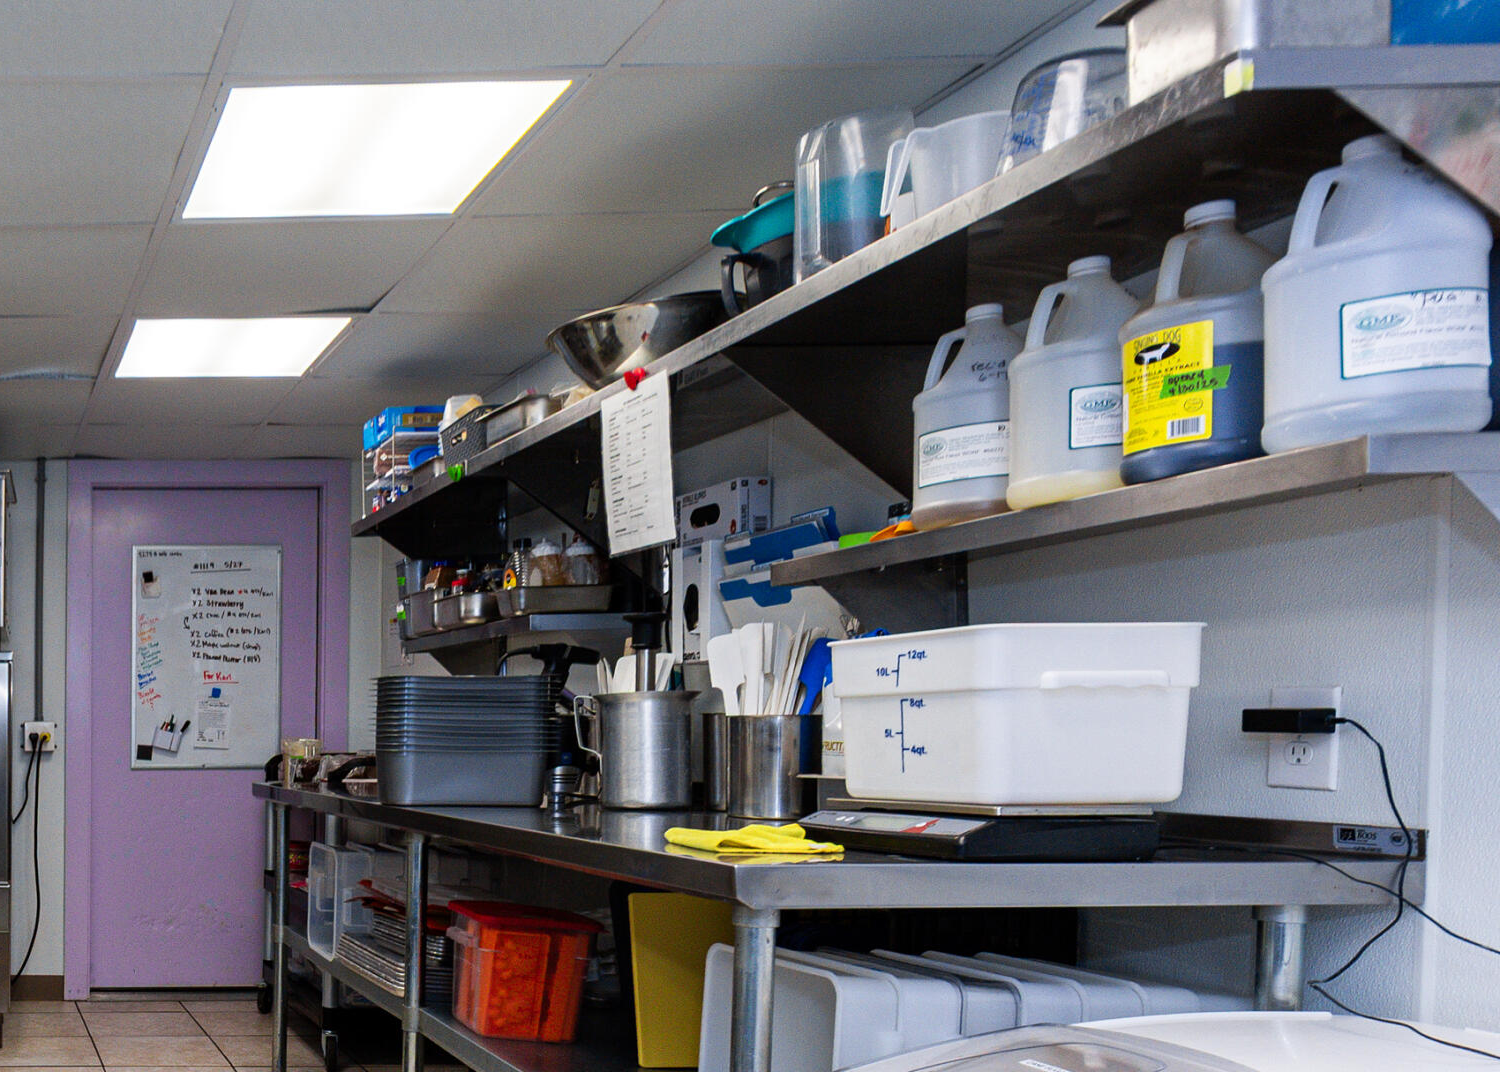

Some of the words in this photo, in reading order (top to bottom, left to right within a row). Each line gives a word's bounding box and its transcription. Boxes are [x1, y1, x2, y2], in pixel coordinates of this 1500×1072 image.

[1162, 327, 1182, 343] DOG
[206, 600, 244, 610] Strawberry
[907, 650, 927, 660] 12qt.
[876, 667, 890, 677] 10L
[909, 698, 926, 709] 8qt.
[884, 728, 895, 738] 5L
[910, 745, 928, 757] 4qt.
